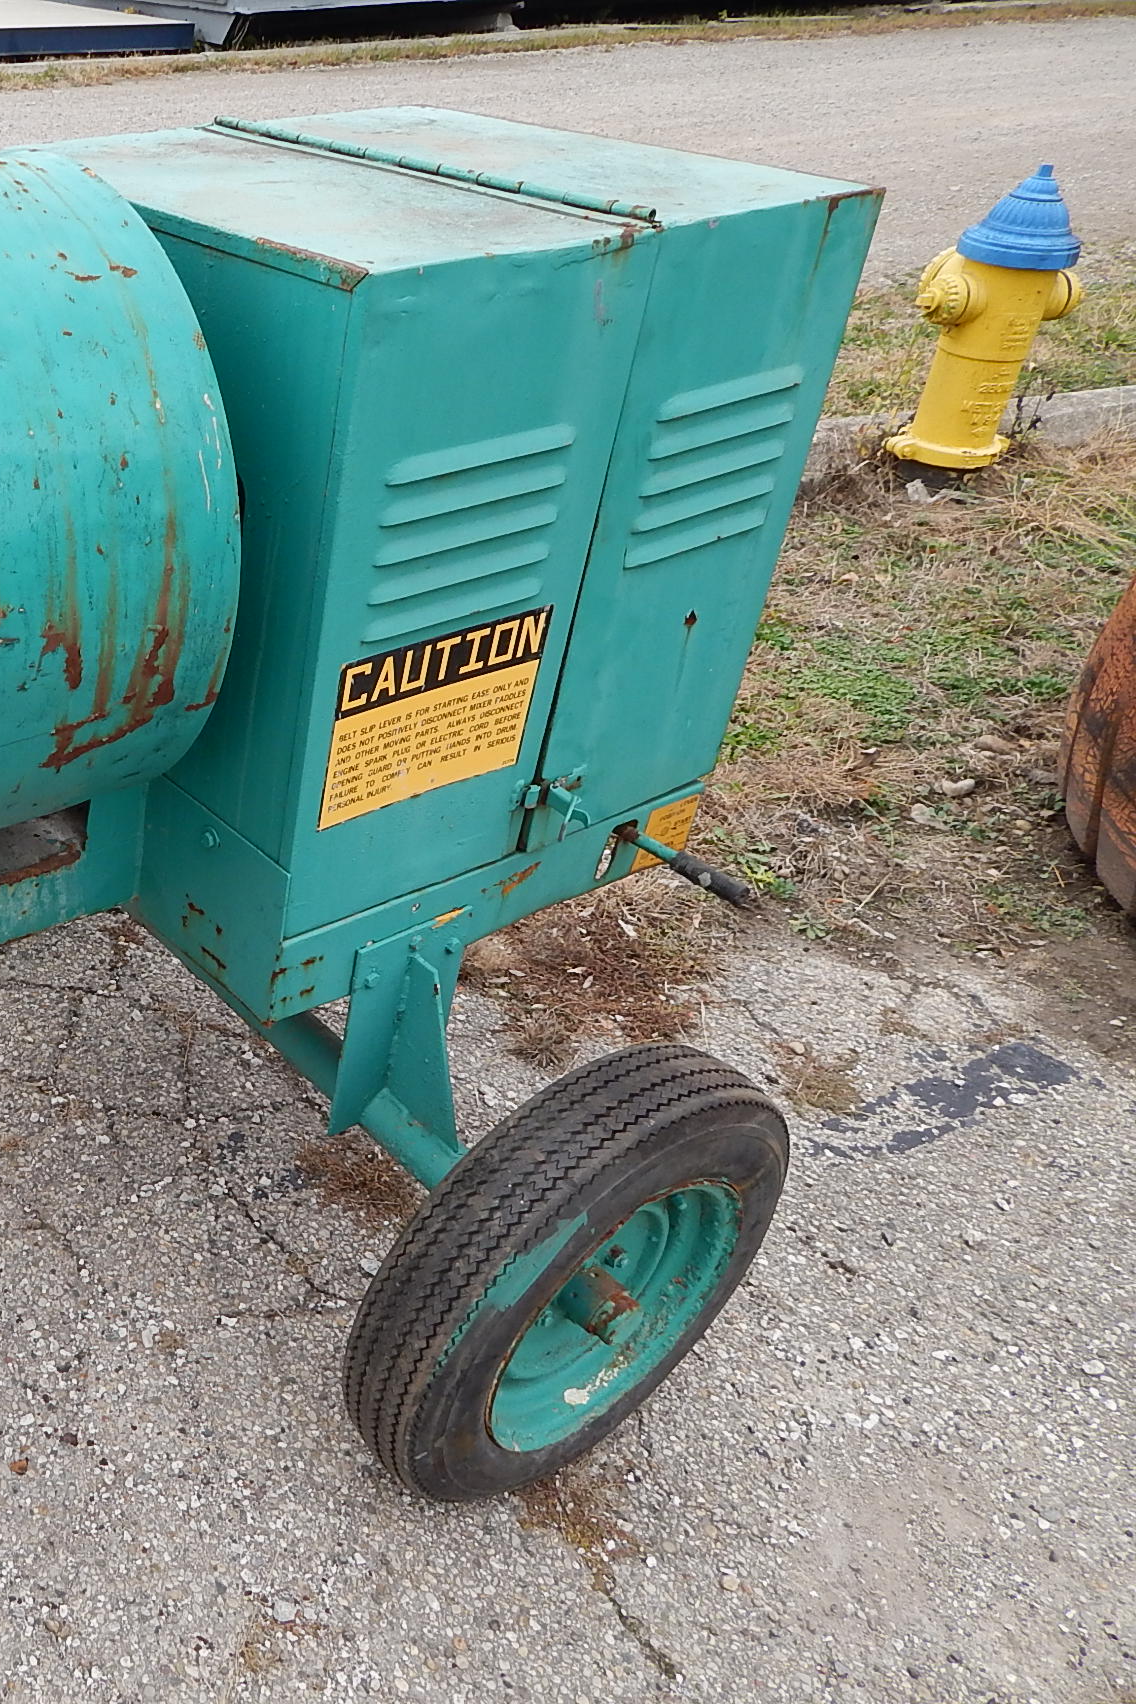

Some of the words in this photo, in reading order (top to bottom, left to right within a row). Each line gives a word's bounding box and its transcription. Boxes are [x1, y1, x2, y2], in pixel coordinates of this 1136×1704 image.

[340, 611, 547, 712] CAUTION
[335, 756, 352, 767] AND
[355, 746, 380, 760] OTHER
[383, 735, 411, 750] MOVING
[446, 714, 476, 730] ALWAYS
[480, 700, 524, 720] DISCONNECT
[336, 742, 356, 755] DOES
[358, 736, 374, 748] NOT
[378, 722, 418, 740] POSITIVELY
[420, 706, 467, 726] DISCONNECT
[470, 698, 492, 711] MIXER
[338, 730, 357, 742] BELT
[360, 724, 376, 736] SLIP
[378, 716, 402, 730] LEVER
[405, 712, 412, 720] IS
[415, 706, 430, 718] FOR
[433, 695, 468, 712] STARTING
[471, 688, 490, 700] EASE
[492, 682, 512, 694] ONLY
[514, 677, 530, 688] AND
[329, 785, 358, 802] FAILURE
[366, 780, 375, 788] TO
[417, 760, 432, 770] CAN
[440, 748, 468, 763] RESULT
[486, 734, 516, 748] SERIOUS
[333, 764, 359, 779] ENGINE
[364, 754, 388, 768] SPARK
[392, 746, 411, 758] PLUG
[416, 740, 426, 750] OR
[430, 729, 464, 746] ELECTRIC
[469, 722, 489, 733] CORD
[494, 712, 522, 726] BEFORE
[368, 762, 392, 777] GUARD
[411, 746, 442, 762] PUTTING
[474, 730, 492, 742] INTO
